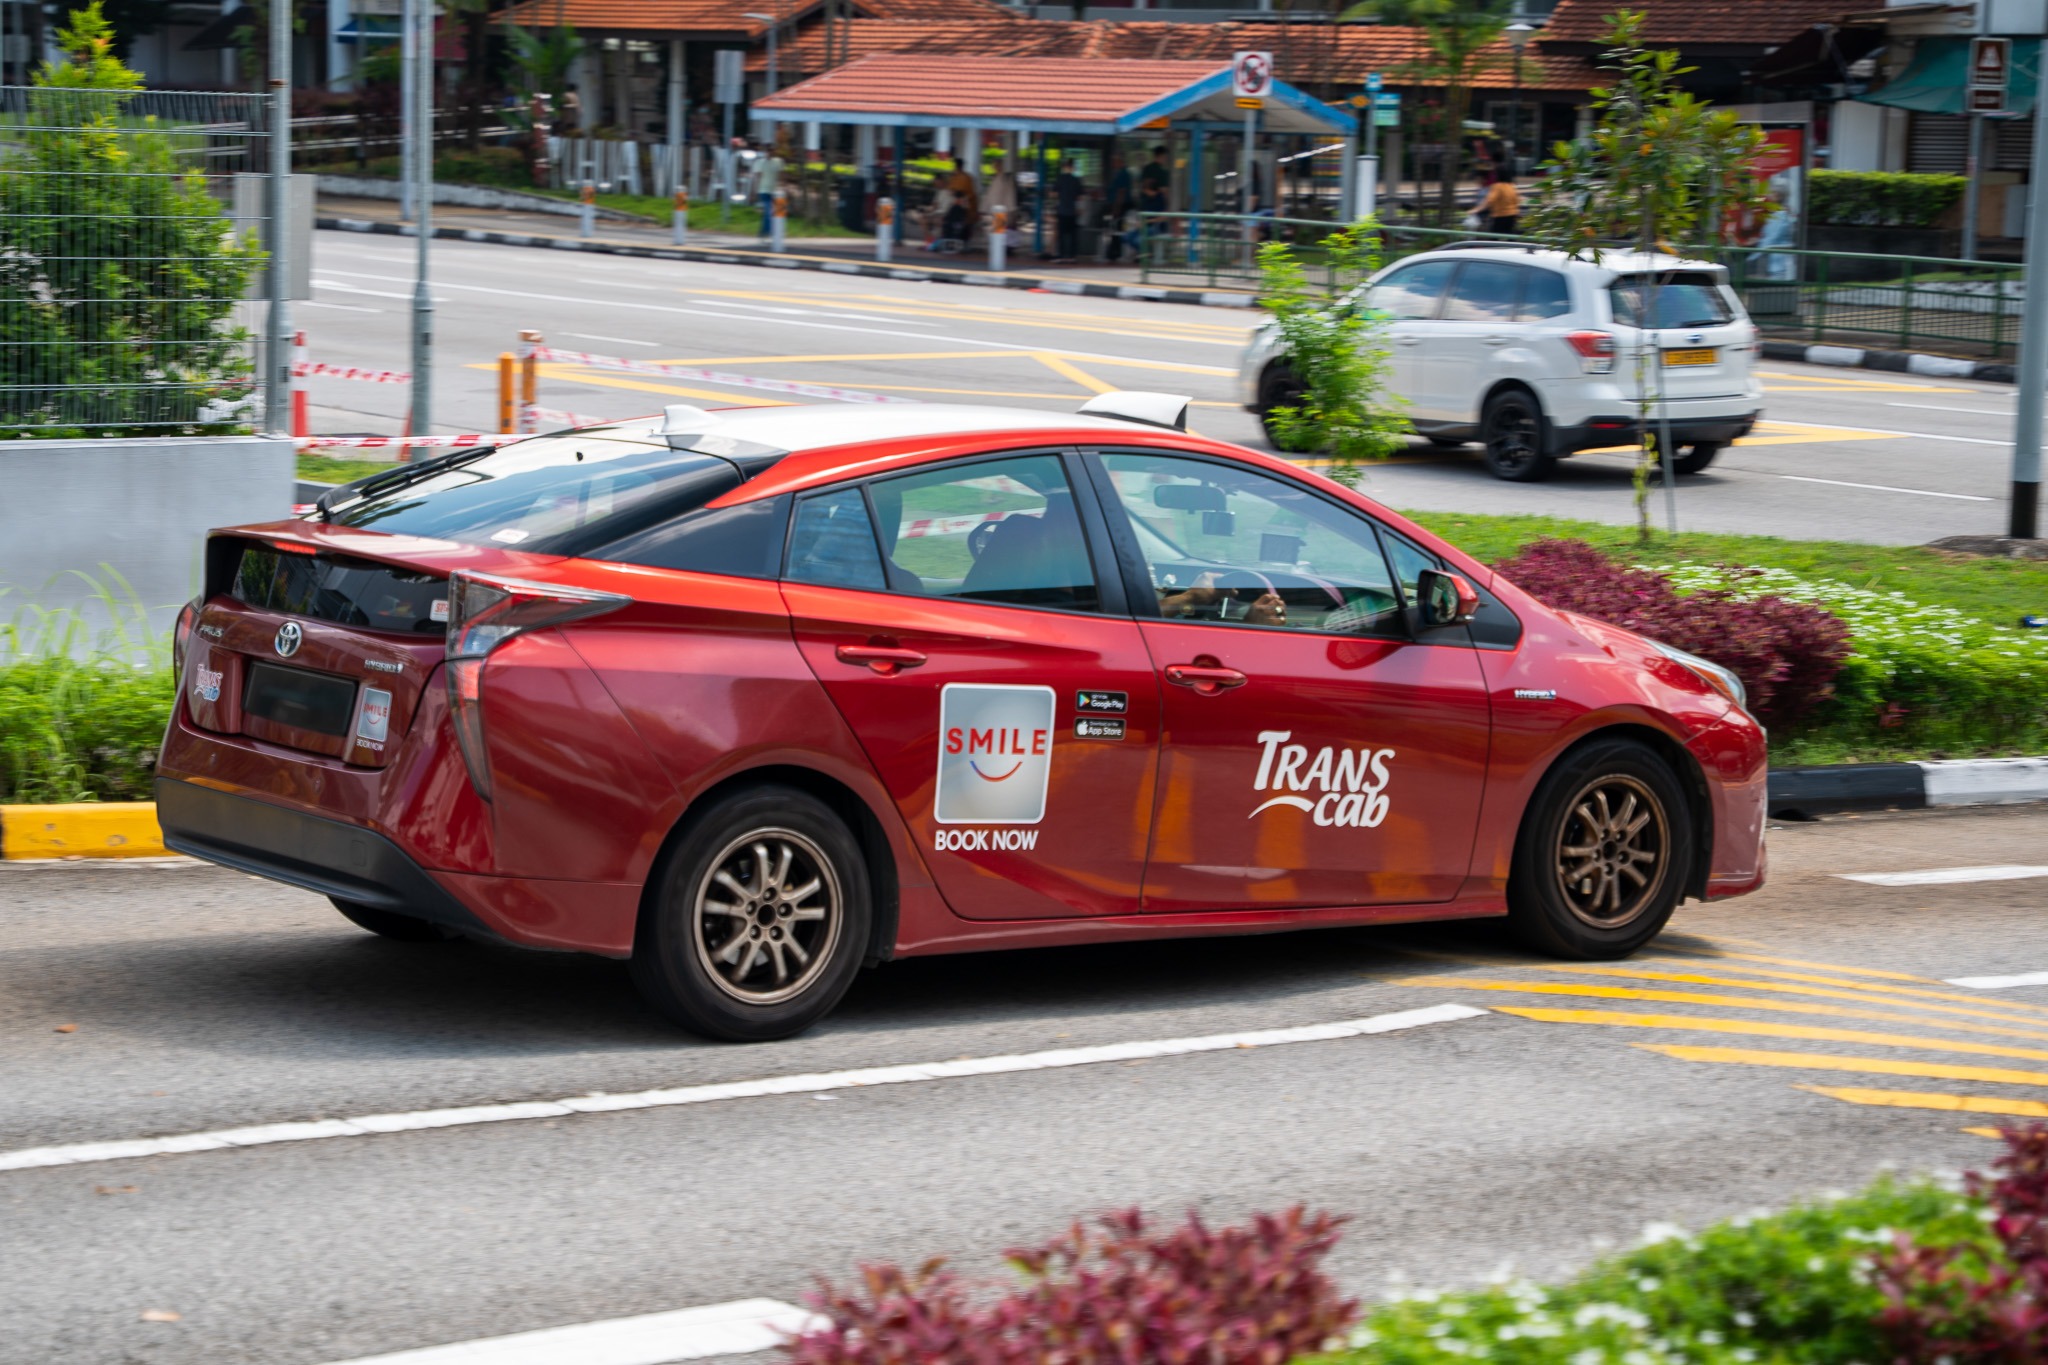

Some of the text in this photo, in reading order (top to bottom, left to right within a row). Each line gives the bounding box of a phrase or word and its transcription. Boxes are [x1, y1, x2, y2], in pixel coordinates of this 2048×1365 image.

[1091, 699, 1124, 710] Google Play
[946, 727, 1048, 756] SMILE
[1088, 727, 1122, 736] App Store
[1253, 730, 1396, 794] TRANS
[1313, 791, 1391, 828] cab
[935, 829, 1039, 851] BOOK NOW
